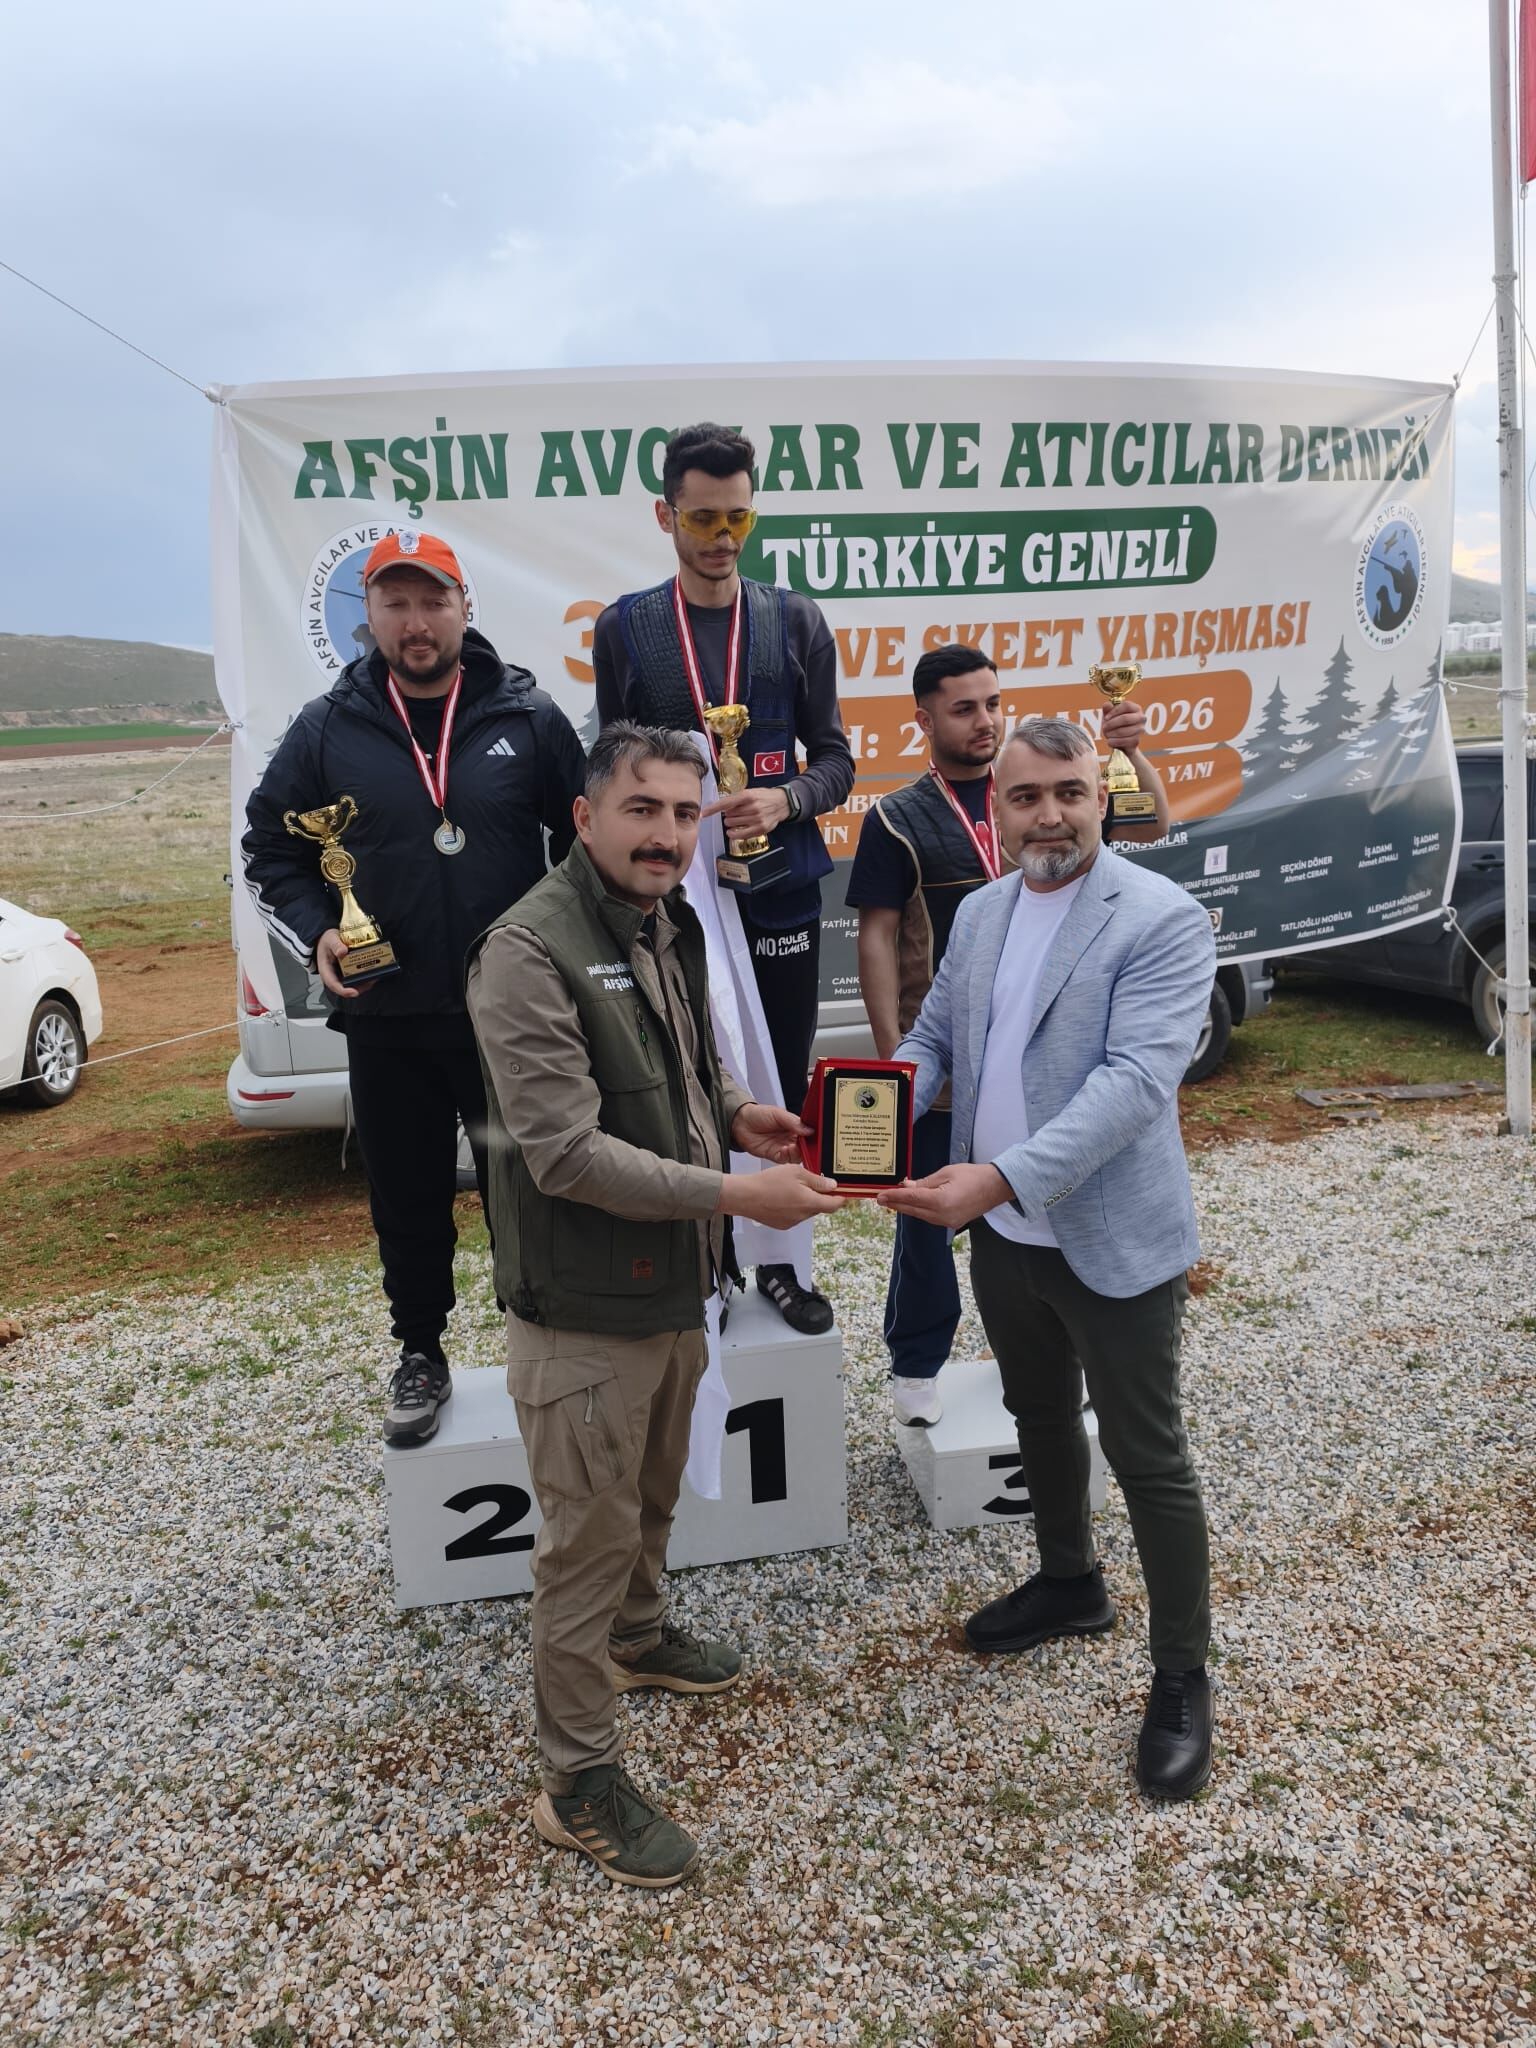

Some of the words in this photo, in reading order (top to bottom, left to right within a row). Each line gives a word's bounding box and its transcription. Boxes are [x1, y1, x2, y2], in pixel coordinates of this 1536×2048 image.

[295, 417, 509, 519] AFŞİN
[535, 424, 863, 496] AVCAR
[887, 422, 980, 489] VE
[1000, 421, 1264, 487] ATICILAR
[762, 521, 1006, 591] TÜRKİYE
[1022, 514, 1193, 585] GENELİ
[310, 538, 353, 613] AVCILAR
[355, 527, 380, 544] VE
[835, 626, 906, 678] VE
[1096, 601, 1312, 668] YARIŞMASI
[1143, 697, 1216, 736] 026
[1168, 760, 1216, 784] YANI
[1371, 843, 1393, 855] ADAMI
[1280, 859, 1307, 875] SEÇKİN
[1307, 855, 1333, 869] DÖNER
[1284, 872, 1306, 884] Ahmet
[822, 917, 850, 929] FATİH
[1280, 916, 1321, 932] TATLIOĞLU
[1321, 910, 1353, 925] MOBİLYA
[756, 937, 777, 957] NO
[778, 931, 809, 946] RULES
[1214, 928, 1257, 943] AMÜLLERİ
[778, 940, 810, 956] LIMITS
[603, 975, 634, 992] AFŞİN
[834, 987, 858, 995] Musa
[724, 1397, 788, 1505] 1
[442, 1483, 536, 1562] 2
